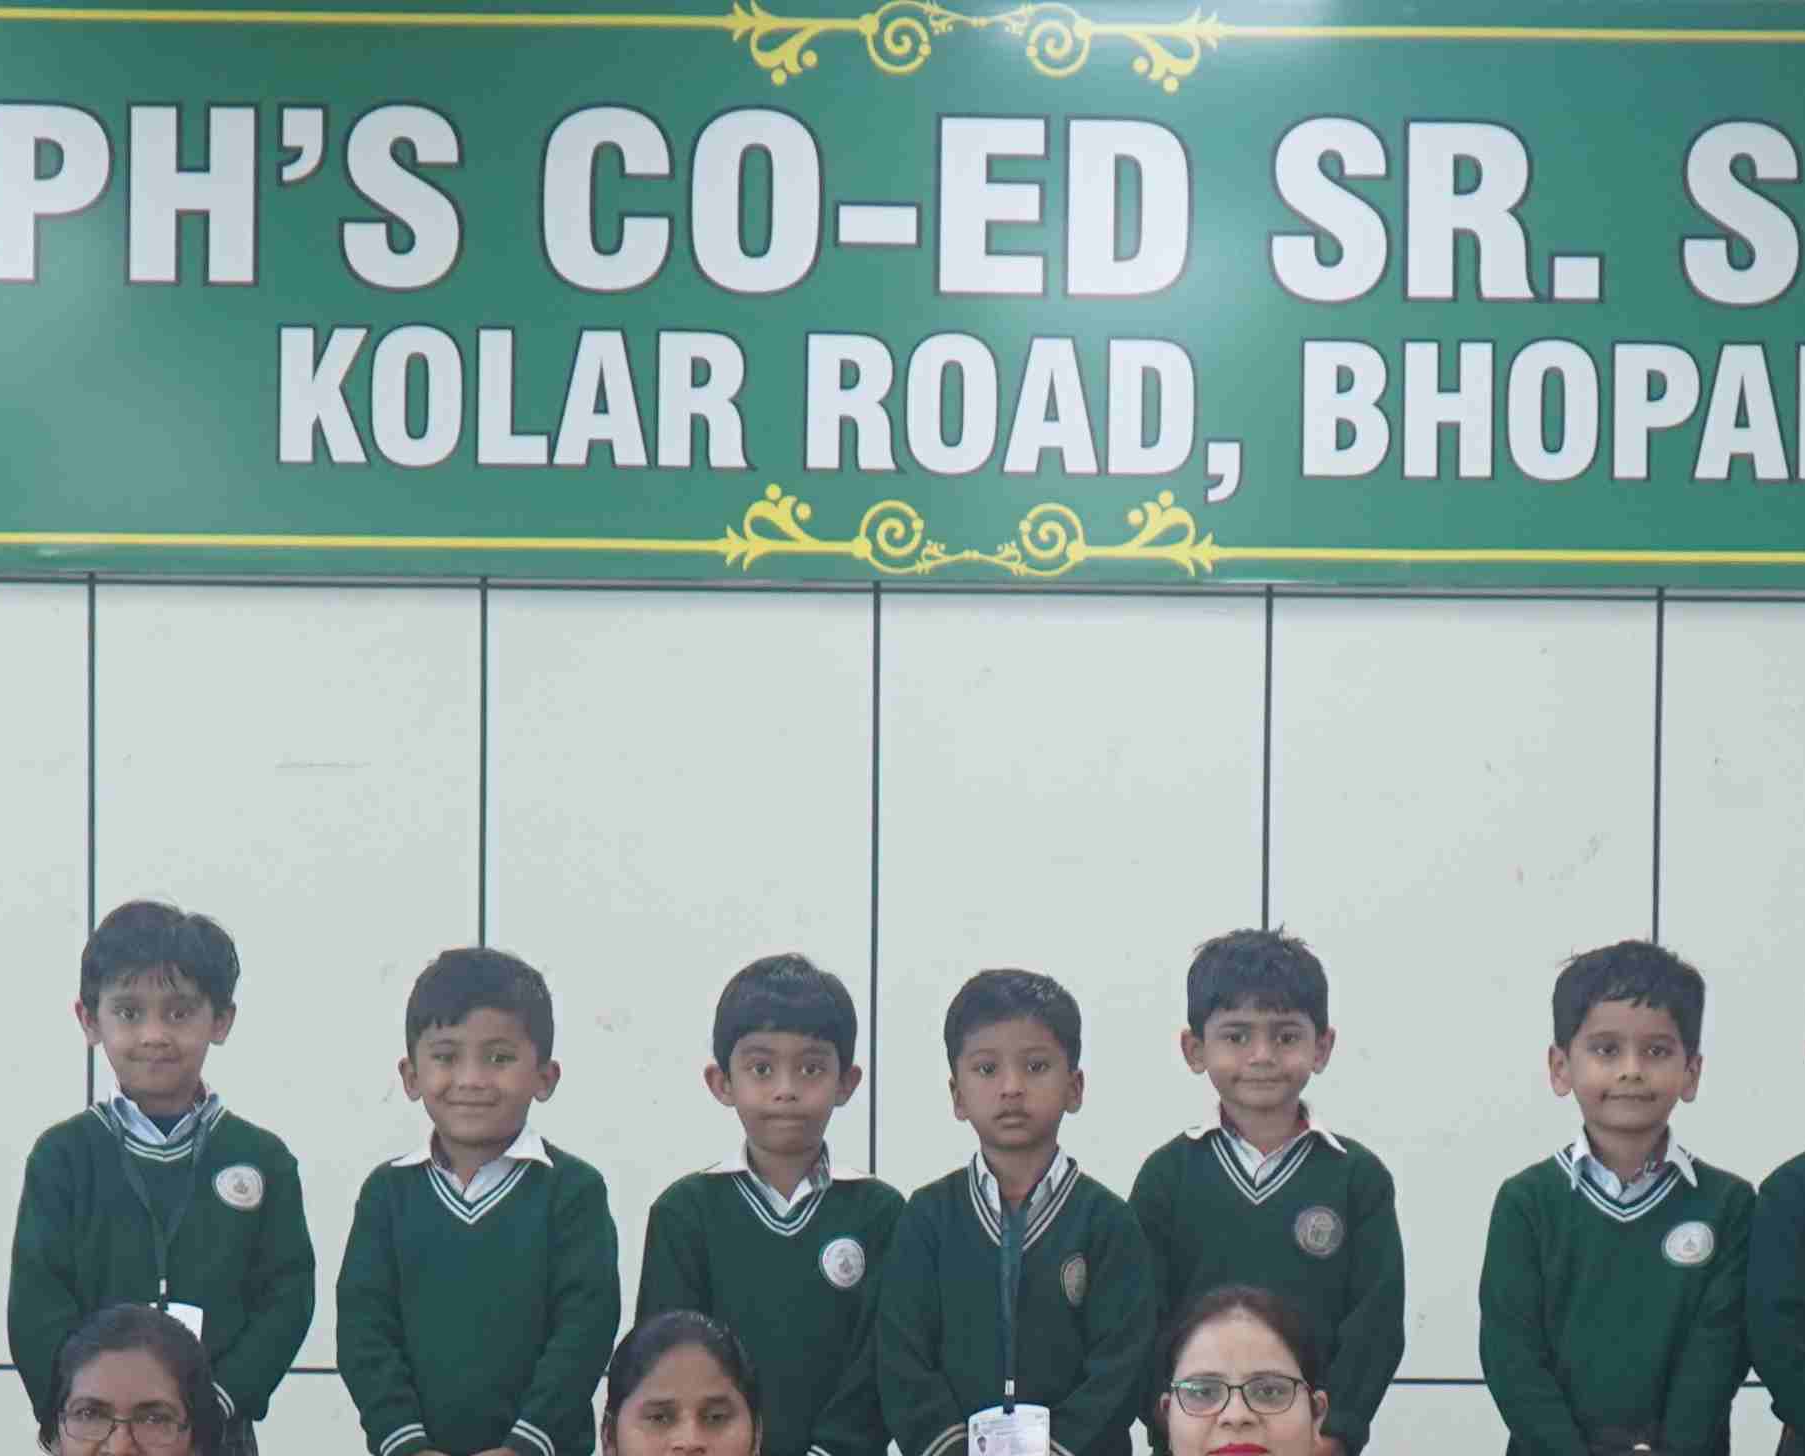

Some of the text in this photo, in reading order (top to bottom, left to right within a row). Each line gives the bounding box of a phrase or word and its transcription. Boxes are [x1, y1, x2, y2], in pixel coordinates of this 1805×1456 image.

[541, 106, 1192, 300] CO-ED
[1269, 115, 1602, 305] SR.
[277, 326, 750, 471] KOLAR
[804, 332, 1243, 504] ROAD,
